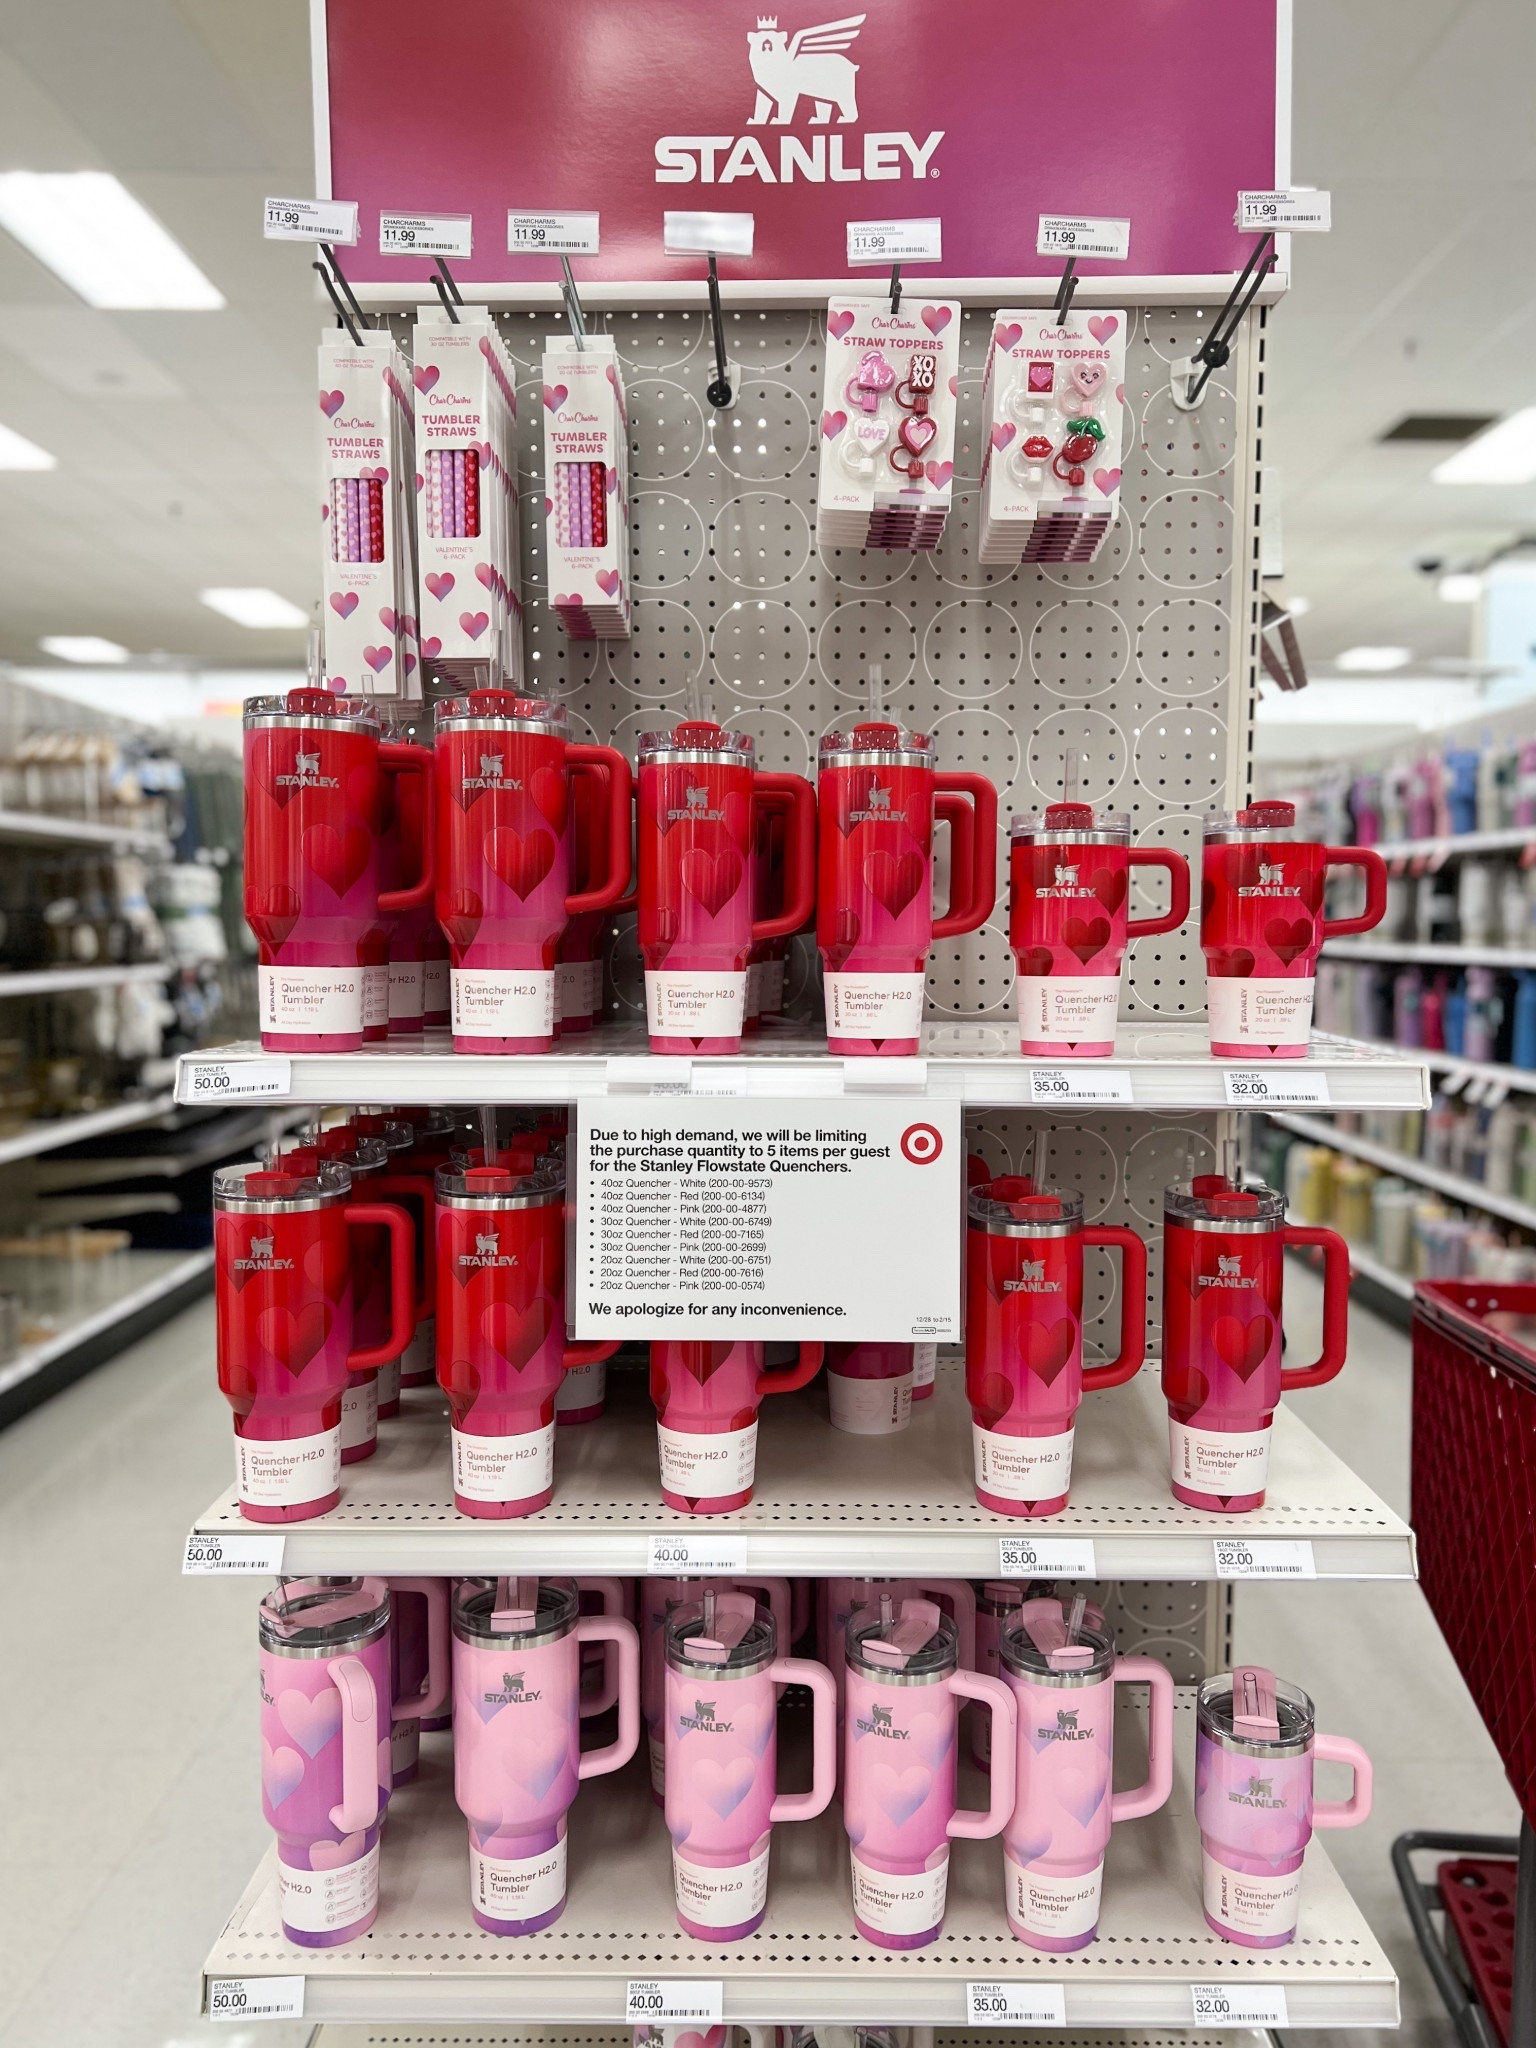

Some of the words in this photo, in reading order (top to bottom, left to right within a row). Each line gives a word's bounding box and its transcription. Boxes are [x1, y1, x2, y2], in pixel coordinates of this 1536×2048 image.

[654, 131, 946, 183] STANLEY
[267, 200, 310, 210] CHARCHARMS
[1246, 204, 1276, 216] 11.99
[268, 211, 300, 224] 11.99
[1044, 220, 1087, 228] CHARCHARMS
[384, 230, 416, 241] 11.99
[514, 229, 546, 240] 11.99
[1044, 232, 1076, 243] 11.99
[854, 237, 885, 248] 11.99
[844, 336, 886, 348] STRAW
[890, 338, 944, 350] TOPPERS
[1012, 349, 1054, 358] STRAW
[1057, 350, 1110, 359] TOPPERS
[913, 355, 934, 372] XO
[912, 371, 934, 388] XO
[422, 415, 480, 424] TUMBLER
[426, 427, 477, 437] STRAWS
[550, 432, 608, 442] TUMBLER
[858, 428, 886, 440] LOVE
[327, 438, 384, 448] TUMBLER
[332, 450, 380, 459] STRAWS
[556, 444, 604, 454] STRAWS
[833, 495, 860, 503] 4-PACK
[276, 774, 340, 788] STANLEY
[462, 778, 523, 790] STANLEY
[668, 809, 725, 821] STANLEY
[850, 811, 908, 822] STANLEY
[1036, 888, 1096, 898] STANLEY
[1238, 886, 1300, 897] STANLEY
[282, 984, 332, 994] Quencher
[334, 984, 354, 992] H2.0
[282, 995, 324, 1004] Tumbler
[194, 1066, 224, 1074] STANLEY
[194, 1076, 230, 1090] 50.00
[1034, 1081, 1070, 1092] 35.00
[1232, 1083, 1268, 1094] 32.00
[590, 1128, 619, 1141] Due
[622, 1129, 638, 1141] to
[641, 1128, 672, 1144] high
[675, 1128, 738, 1144] demand,
[741, 1131, 763, 1142] we
[766, 1128, 790, 1142] will
[793, 1129, 812, 1142] be
[815, 1129, 867, 1145] limiting
[589, 1143, 613, 1157] the
[616, 1144, 684, 1159] purchase
[687, 1144, 746, 1160] quantity
[748, 1145, 764, 1157] to
[766, 1144, 776, 1157] 5
[779, 1144, 819, 1157] items
[822, 1147, 847, 1160] per
[849, 1145, 891, 1160] guest
[589, 1159, 610, 1172] for
[612, 1159, 637, 1172] the
[640, 1159, 694, 1175] Stanley
[697, 1159, 766, 1173] Flowstate
[769, 1159, 852, 1173] Quenchers.
[601, 1179, 624, 1188] 40oz
[626, 1179, 672, 1188] Quencher
[680, 1179, 707, 1188] White
[709, 1179, 773, 1189] (200-00-9573)
[601, 1192, 624, 1201] 40oz
[626, 1192, 672, 1201] Quencher
[681, 1192, 699, 1201] Red
[702, 1191, 766, 1202] (200-00-6134)
[601, 1204, 624, 1214] 40oz
[626, 1204, 672, 1214] Quencher
[681, 1205, 700, 1214] Pink
[702, 1204, 767, 1215] (200-00-4877)
[601, 1217, 624, 1226] 30oz
[626, 1217, 672, 1227] Quencher
[680, 1217, 707, 1227] White
[709, 1216, 773, 1227] (200-00-6749)
[601, 1230, 624, 1239] 30oz
[626, 1230, 672, 1239] Quencher
[680, 1230, 699, 1239] Red
[702, 1229, 765, 1240] (200-00-7165)
[601, 1243, 623, 1252] 30oz
[626, 1243, 672, 1252] Quencher
[680, 1243, 700, 1252] Pink
[702, 1242, 767, 1253] (200-00-2699)
[233, 1258, 294, 1270] STANLEY
[458, 1254, 518, 1266] STANLEY
[601, 1256, 623, 1265] 20oz
[626, 1256, 671, 1265] Quencher
[680, 1256, 706, 1265] White
[708, 1255, 772, 1266] (200-00-6751)
[601, 1268, 623, 1277] 20oz
[626, 1268, 671, 1278] Quencher
[680, 1268, 699, 1278] Red
[701, 1268, 764, 1278] (200-00-7616)
[601, 1281, 623, 1290] 20oz
[625, 1281, 671, 1290] Quencher
[680, 1281, 700, 1290] Pink
[702, 1281, 766, 1291] (200-00-0574)
[1003, 1280, 1062, 1293] STANLEY
[1198, 1275, 1260, 1288] STANLEY
[588, 1302, 612, 1315] We
[615, 1302, 685, 1318] apologize
[687, 1302, 709, 1316] for
[711, 1305, 738, 1318] any
[740, 1302, 847, 1316] inconvenience.
[466, 1450, 514, 1462] Quencher
[516, 1447, 538, 1460] H2.0
[992, 1450, 1038, 1464] Quencher
[1040, 1453, 1060, 1462] H2.0
[467, 1462, 506, 1473] Tumbler
[992, 1460, 1030, 1474] Tumbler
[187, 1548, 222, 1560] 50.00
[654, 1549, 688, 1561] 40.00
[1002, 1552, 1036, 1564] 35.00
[1218, 1553, 1253, 1564] 32.00
[484, 1690, 543, 1704] STANLEY
[680, 1716, 734, 1733] STANLEY
[856, 1718, 912, 1741] STANLEY
[1037, 1726, 1094, 1741] STANLEY
[1228, 1792, 1288, 1809] STANLEY
[490, 1872, 536, 1882] Quencher
[538, 1860, 557, 1878] H2.0
[490, 1882, 530, 1893] Tumbler
[214, 1982, 243, 1990] STANLEY
[213, 1994, 247, 2008] 50.00
[630, 1996, 663, 2008] 40.00
[974, 1998, 1007, 2012] 35.00
[1196, 2000, 1230, 2012] 32.00
